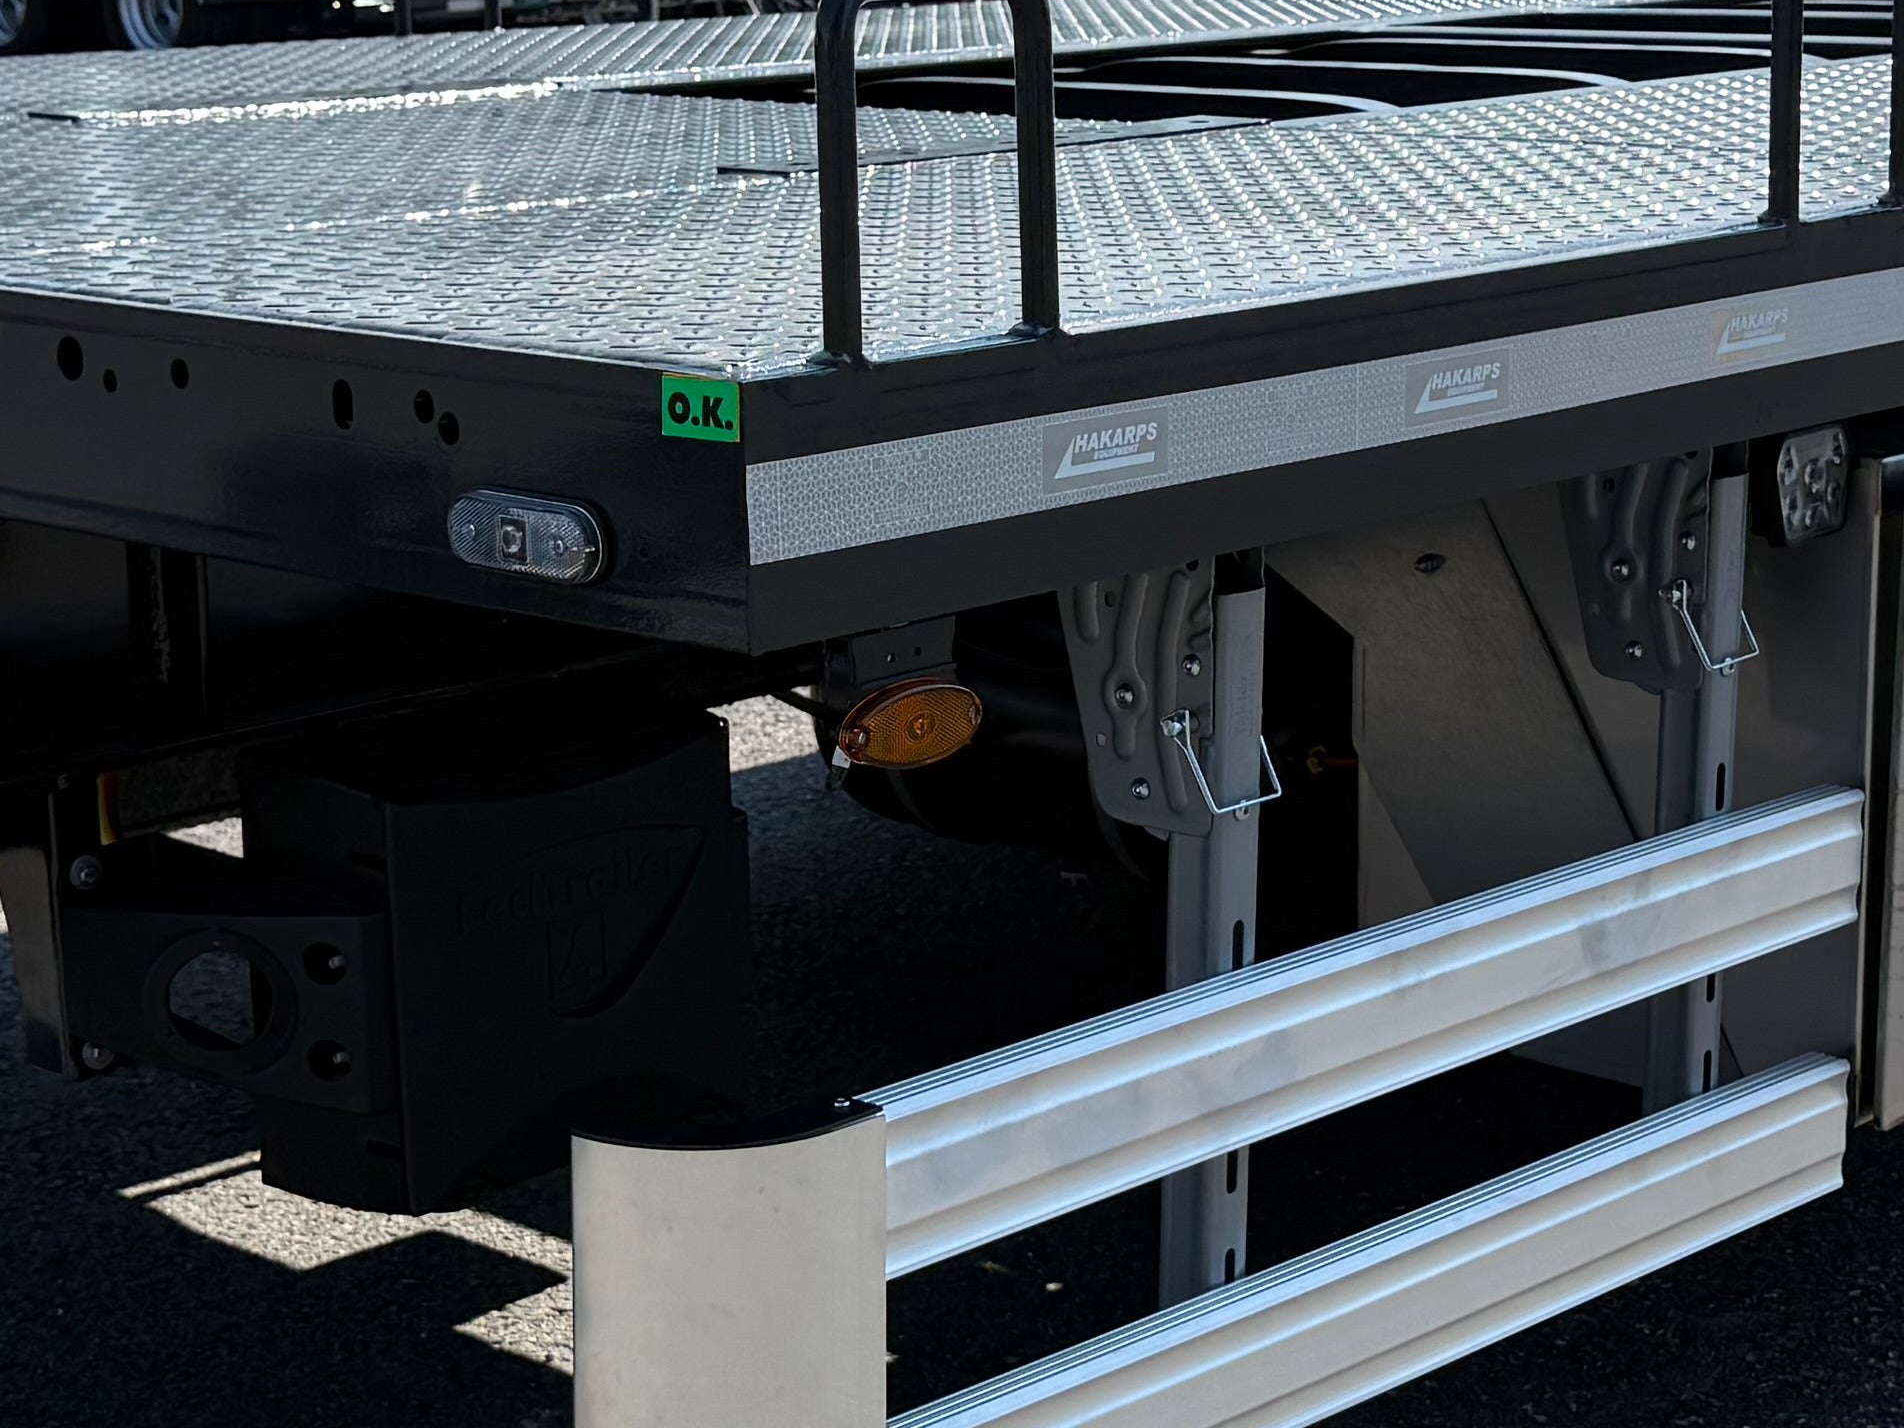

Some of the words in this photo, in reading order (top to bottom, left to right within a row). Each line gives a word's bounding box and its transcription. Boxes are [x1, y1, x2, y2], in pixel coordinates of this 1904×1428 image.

[1730, 308, 1789, 332] HAKARPS
[1432, 362, 1501, 390] HAKARPS
[667, 391, 734, 431] O.K.
[1075, 422, 1158, 453] HAKARPS
